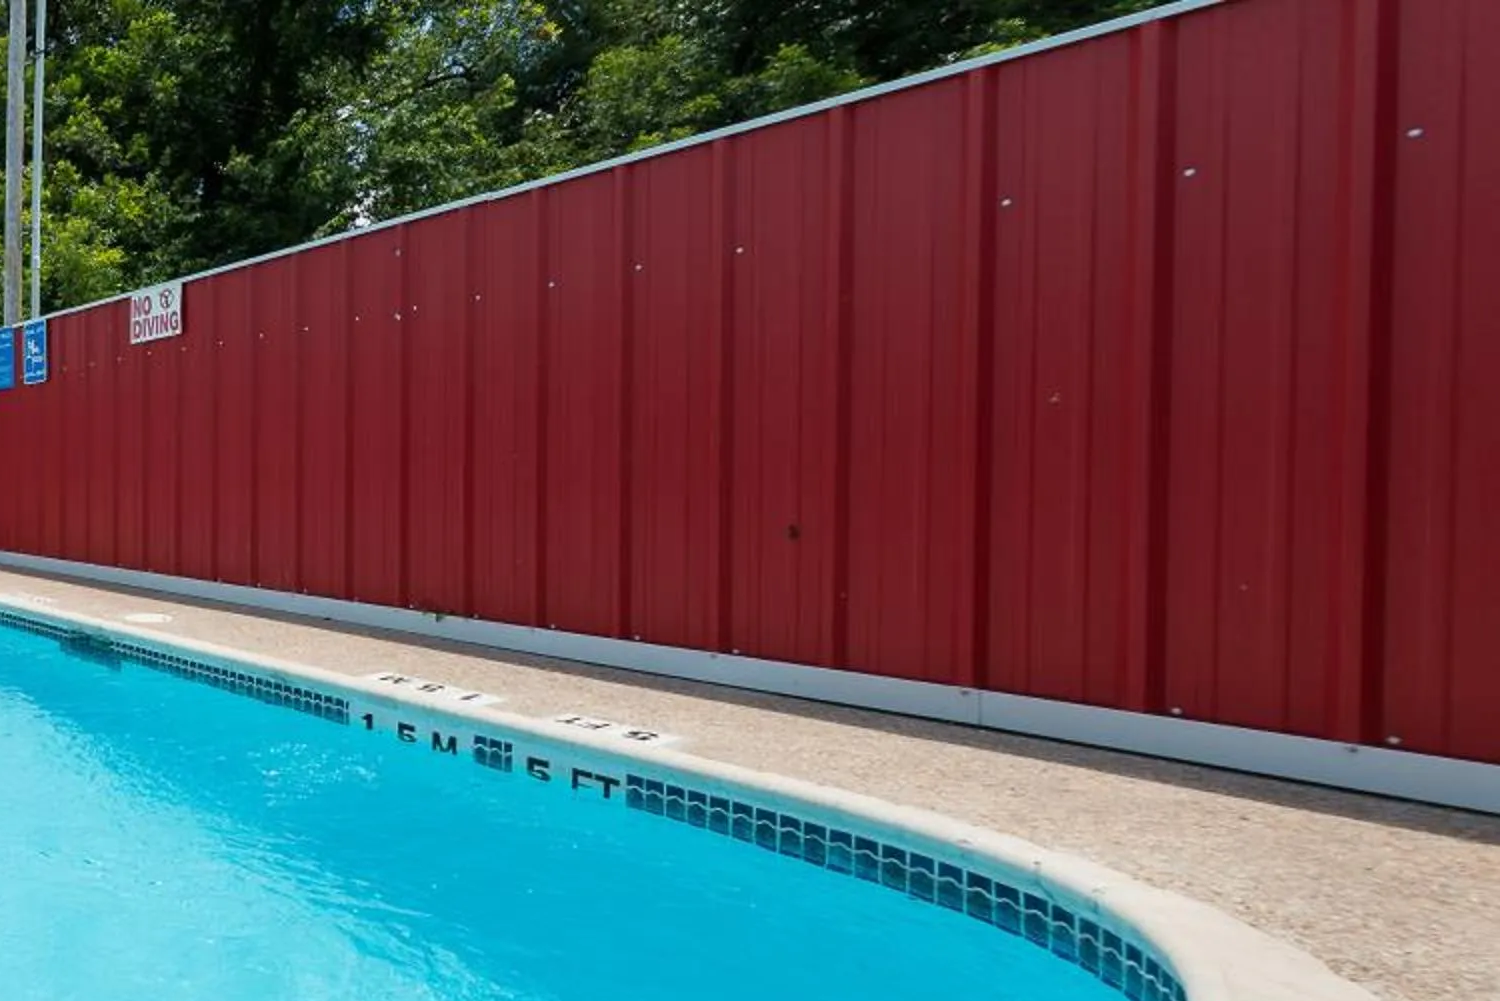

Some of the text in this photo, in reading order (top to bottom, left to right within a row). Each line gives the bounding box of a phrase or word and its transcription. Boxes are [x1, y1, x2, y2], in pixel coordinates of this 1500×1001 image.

[132, 295, 152, 319] NO
[133, 311, 179, 338] DIVING
[571, 767, 621, 800] FT
